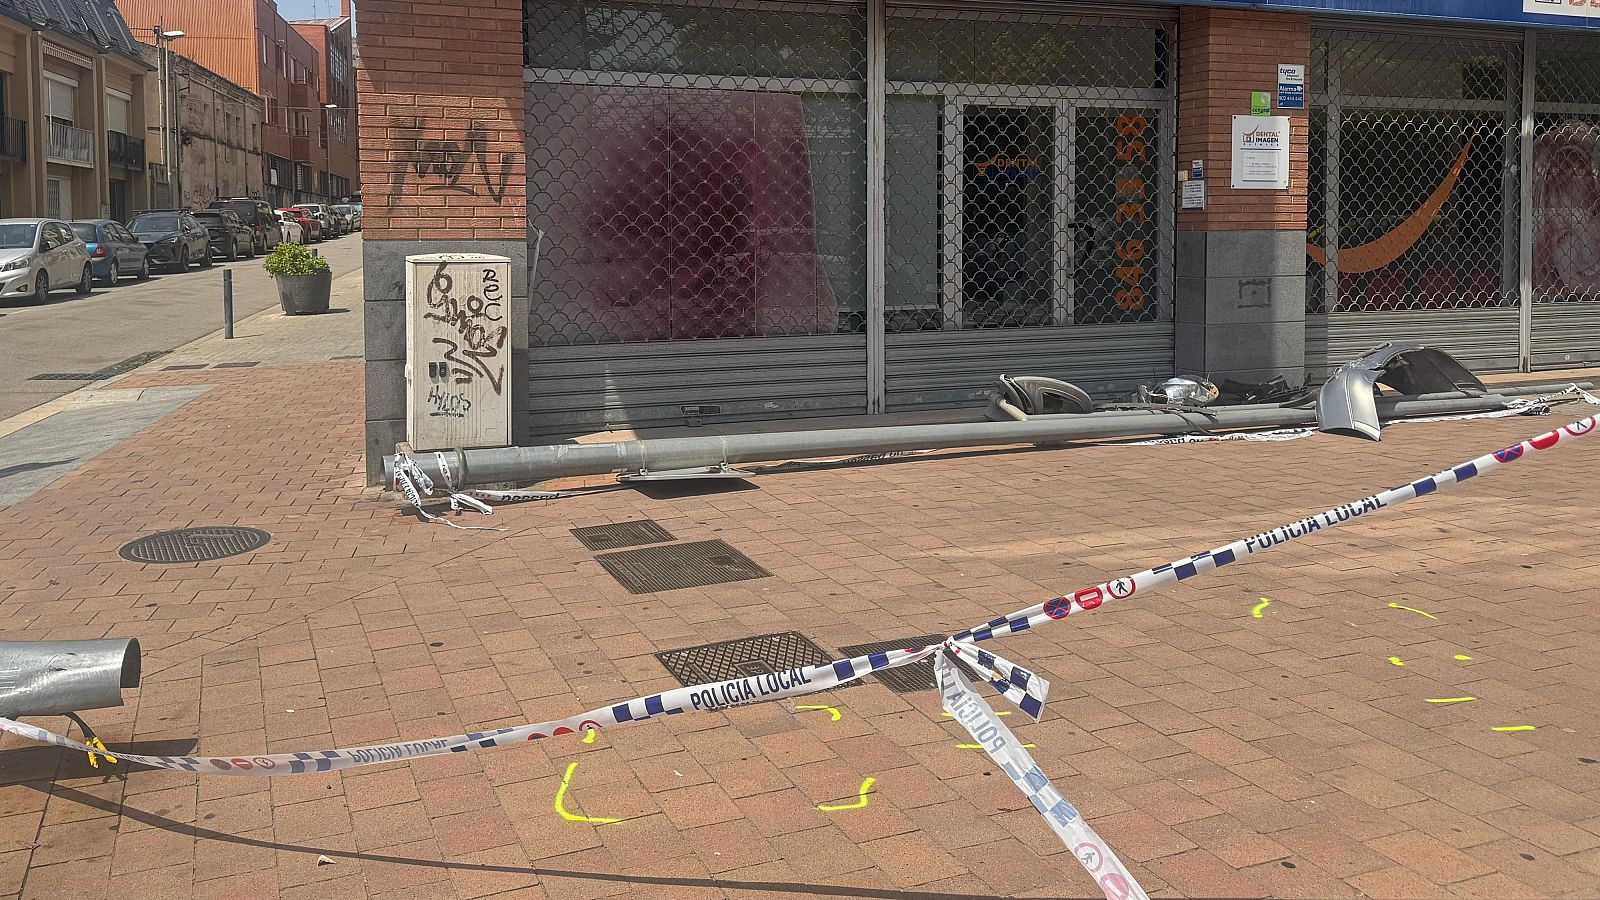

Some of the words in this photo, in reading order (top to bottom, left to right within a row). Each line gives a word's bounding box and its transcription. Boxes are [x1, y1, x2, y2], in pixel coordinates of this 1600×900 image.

[1279, 67, 1296, 75] tyco
[1243, 517, 1321, 553] POLICIA
[1322, 495, 1388, 526] LOCAL
[690, 679, 756, 710] POLICIA
[757, 667, 812, 696] LOCAL
